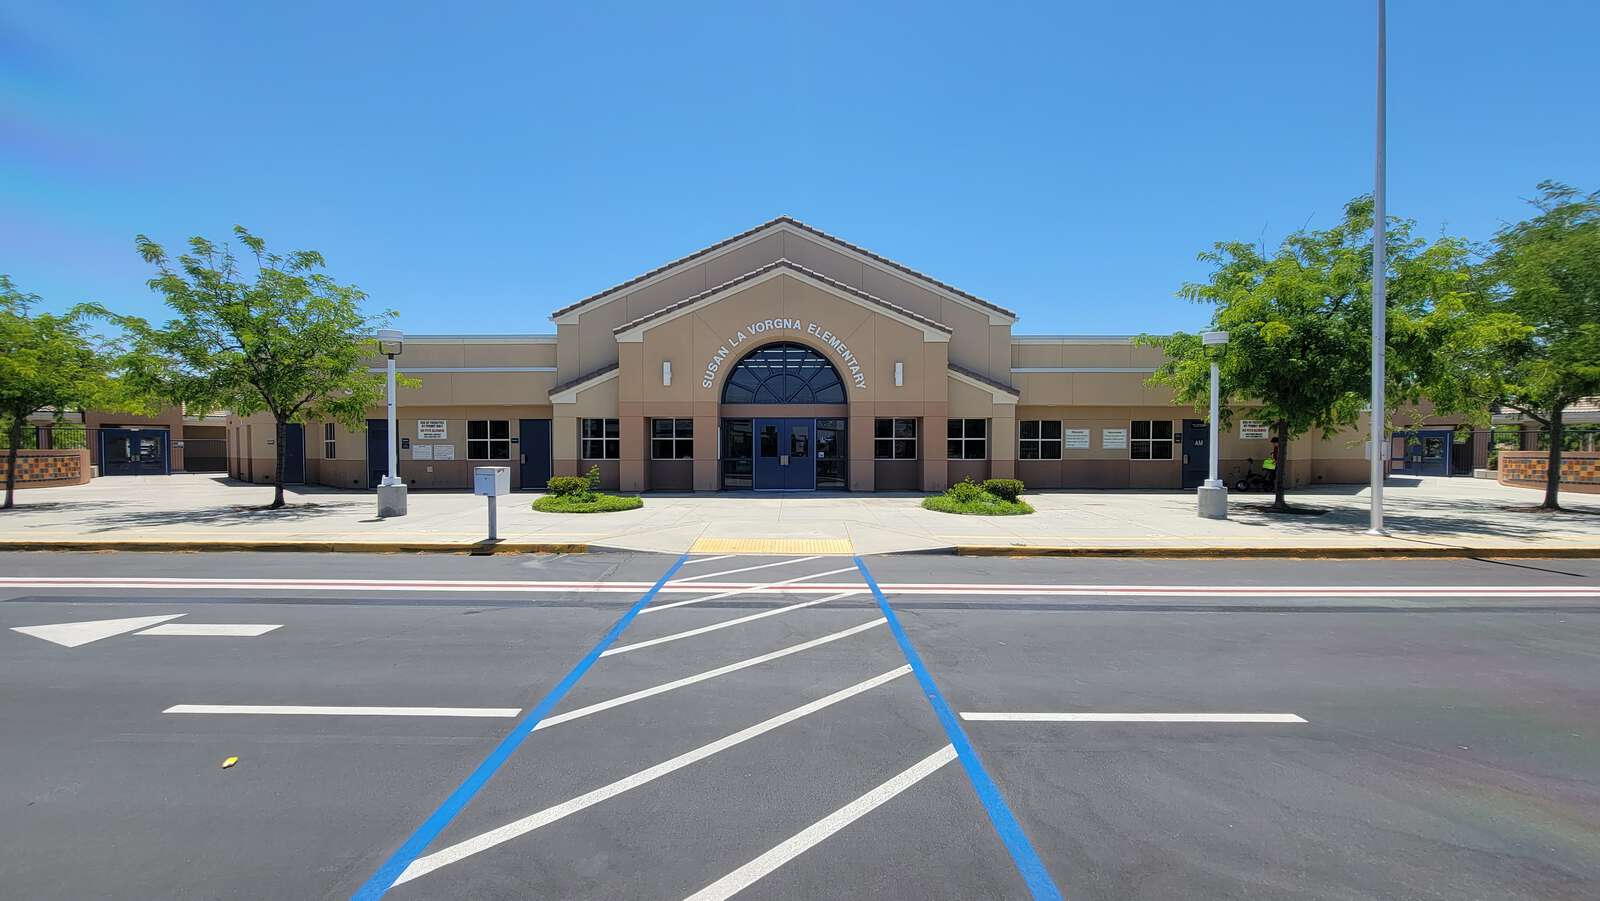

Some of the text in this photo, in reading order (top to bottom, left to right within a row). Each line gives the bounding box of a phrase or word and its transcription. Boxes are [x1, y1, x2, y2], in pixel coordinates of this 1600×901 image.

[702, 318, 867, 390] SUSAN LA VORGNA ELEMENTARY
